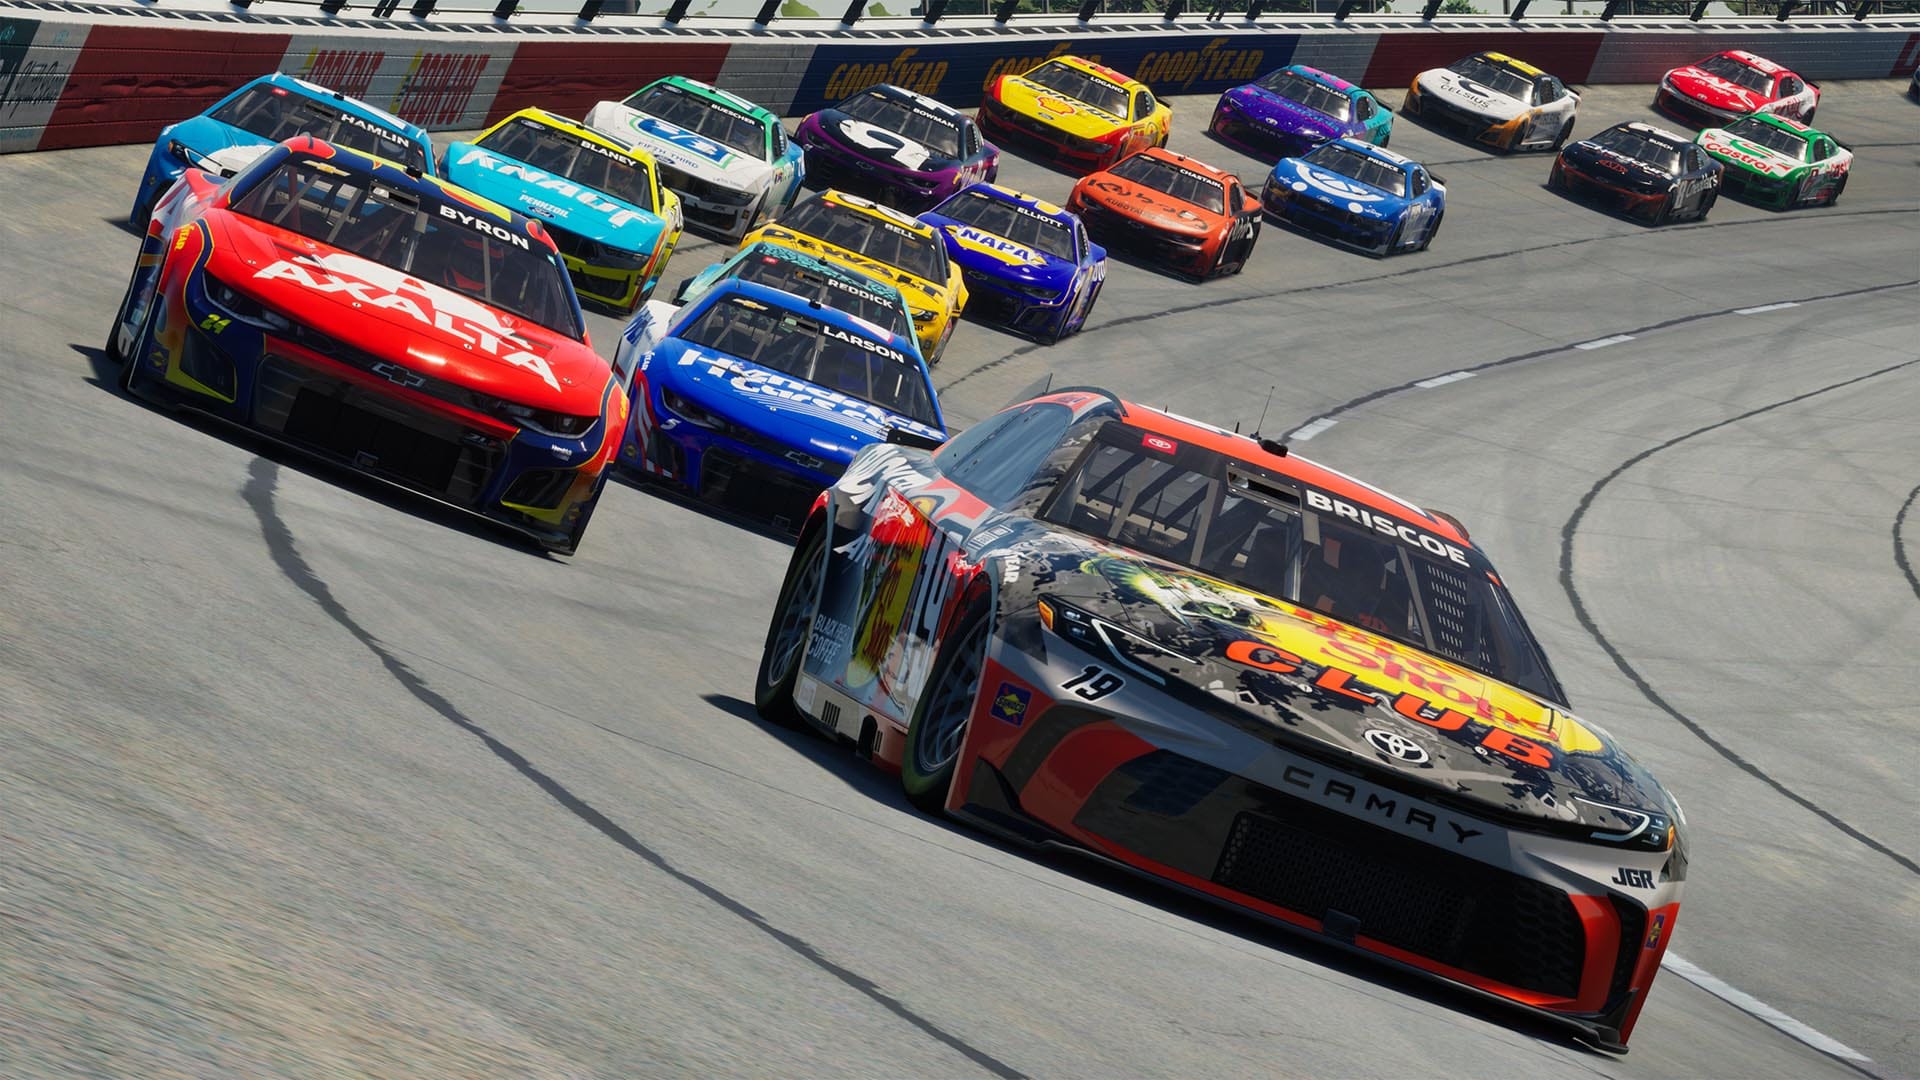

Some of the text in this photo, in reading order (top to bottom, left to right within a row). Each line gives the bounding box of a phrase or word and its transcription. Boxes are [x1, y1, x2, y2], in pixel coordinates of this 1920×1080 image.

[823, 61, 948, 100] GOODYEAR
[1136, 50, 1264, 83] GOODYEAR
[1090, 76, 1124, 94] LOGANO
[1316, 83, 1348, 100] WALLACE
[1440, 83, 1490, 108] CELSIUS
[711, 103, 755, 126] BUESCHER
[913, 107, 955, 128] BOWMAN
[341, 113, 409, 148] HAMLIN
[1649, 138, 1674, 151] BUSCH
[580, 140, 637, 167] BLANEY
[670, 153, 699, 169] THIRD
[1367, 156, 1400, 172] PREECE
[1704, 141, 1773, 175] Castrol
[457, 149, 648, 228] KNAUF
[1180, 168, 1221, 189] CHASTAIN
[519, 194, 570, 219] PENNZOIL
[1016, 206, 1064, 228] ELLIOTT
[440, 204, 529, 251] BYRON
[884, 223, 916, 240] BELL
[960, 228, 1030, 261] NAPA
[828, 278, 893, 309] REDDICK
[200, 313, 232, 335] 24
[253, 260, 562, 392] AXALTA
[823, 325, 904, 364] LARSON
[1306, 489, 1470, 568] BRISCOE
[1060, 665, 1125, 702] 19
[1319, 640, 1560, 742] Shops
[1226, 641, 1553, 769] CLUB
[1282, 765, 1483, 844] CAMRY
[1612, 867, 1656, 889] JGR
